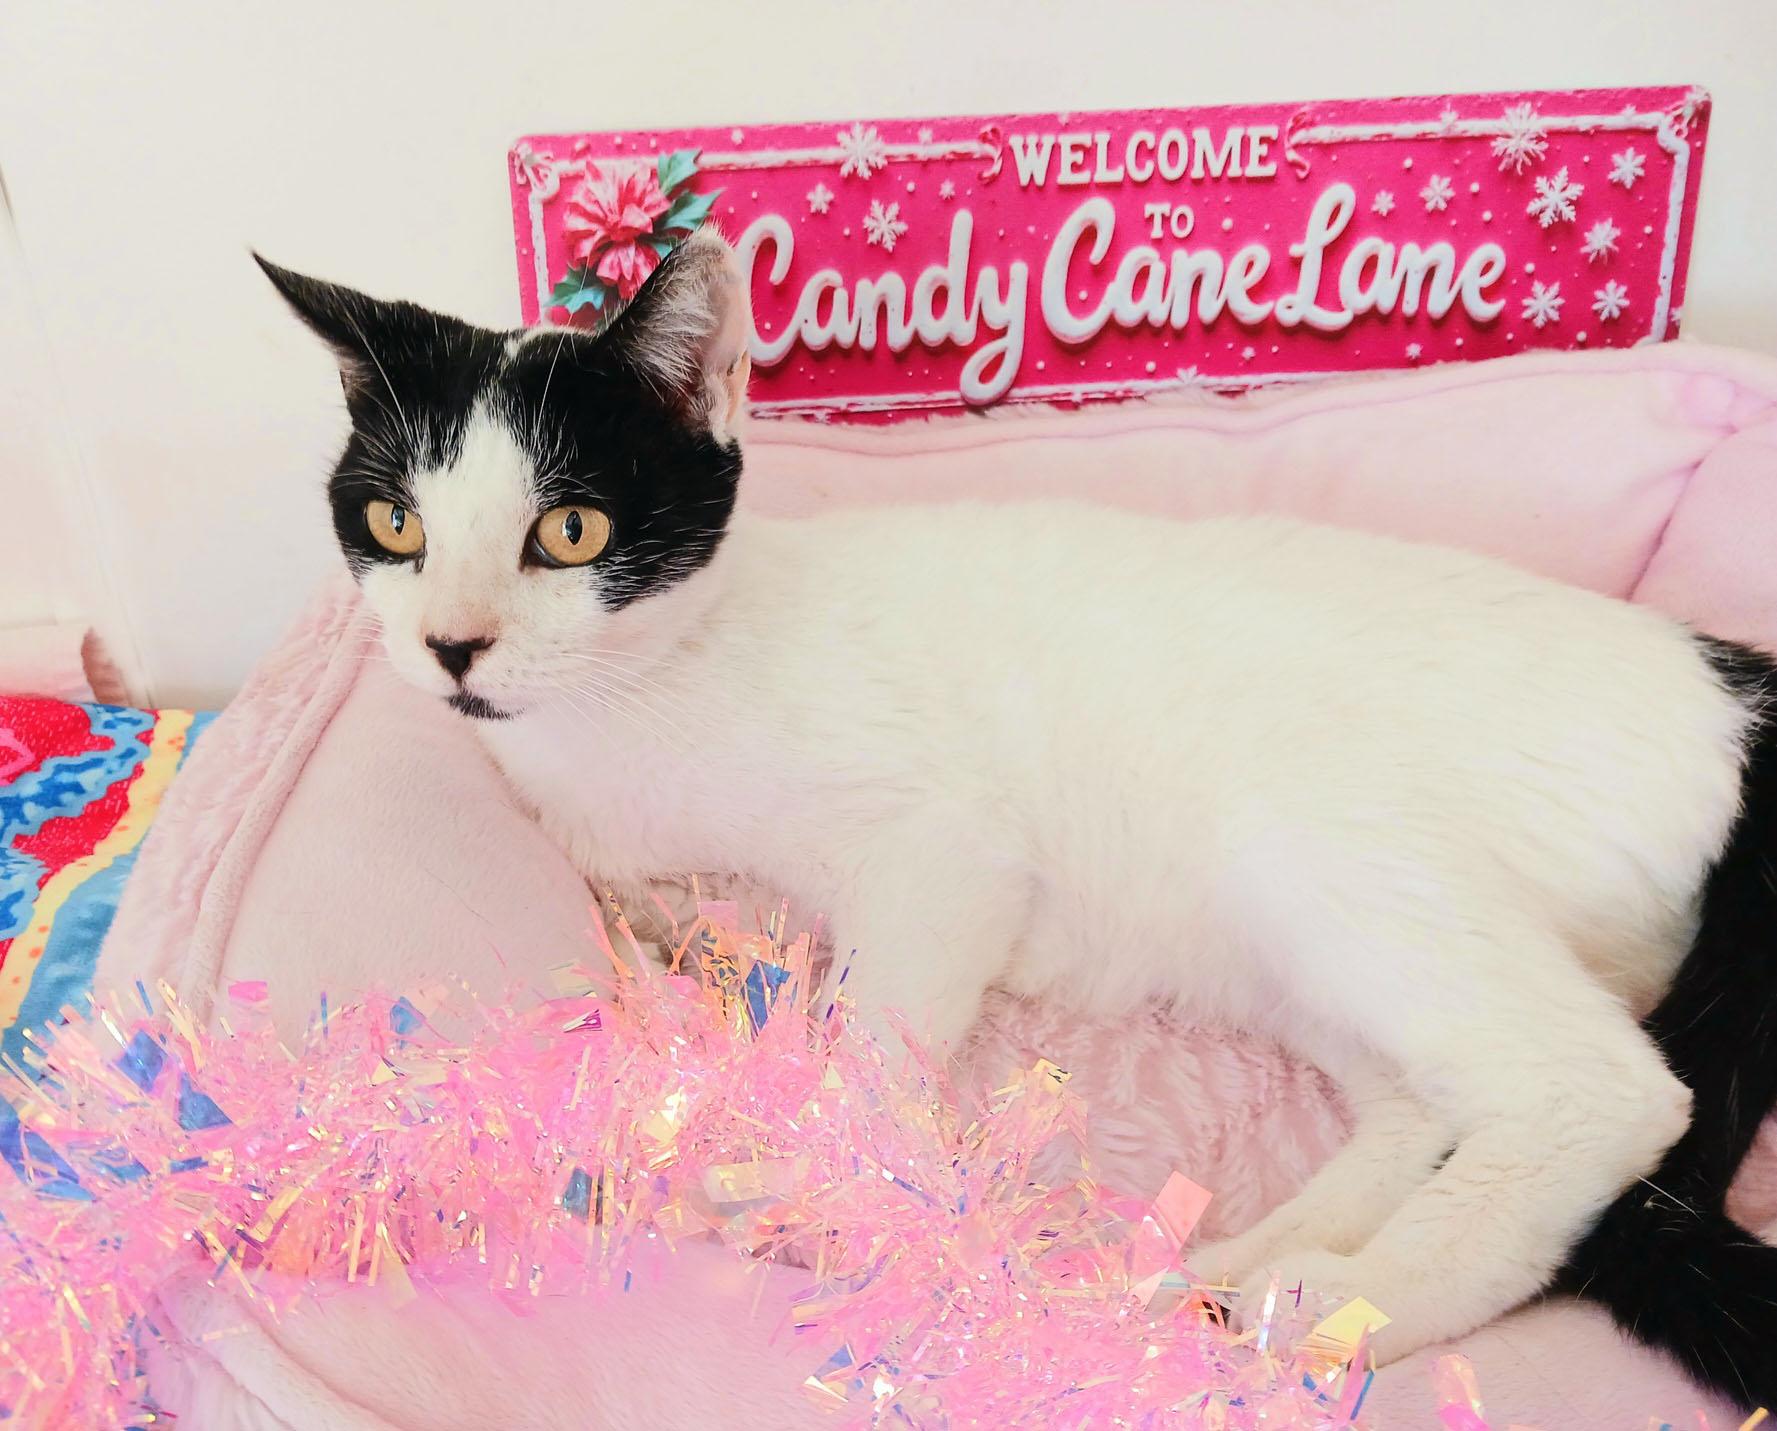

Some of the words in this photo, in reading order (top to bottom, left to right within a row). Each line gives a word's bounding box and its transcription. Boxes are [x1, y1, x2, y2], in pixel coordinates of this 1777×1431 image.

[1008, 125, 1280, 188] WELCOME
[1144, 202, 1196, 240] TO
[735, 213, 1029, 406] Candy
[1040, 197, 1276, 344] Cane
[1275, 182, 1507, 332] Lane
